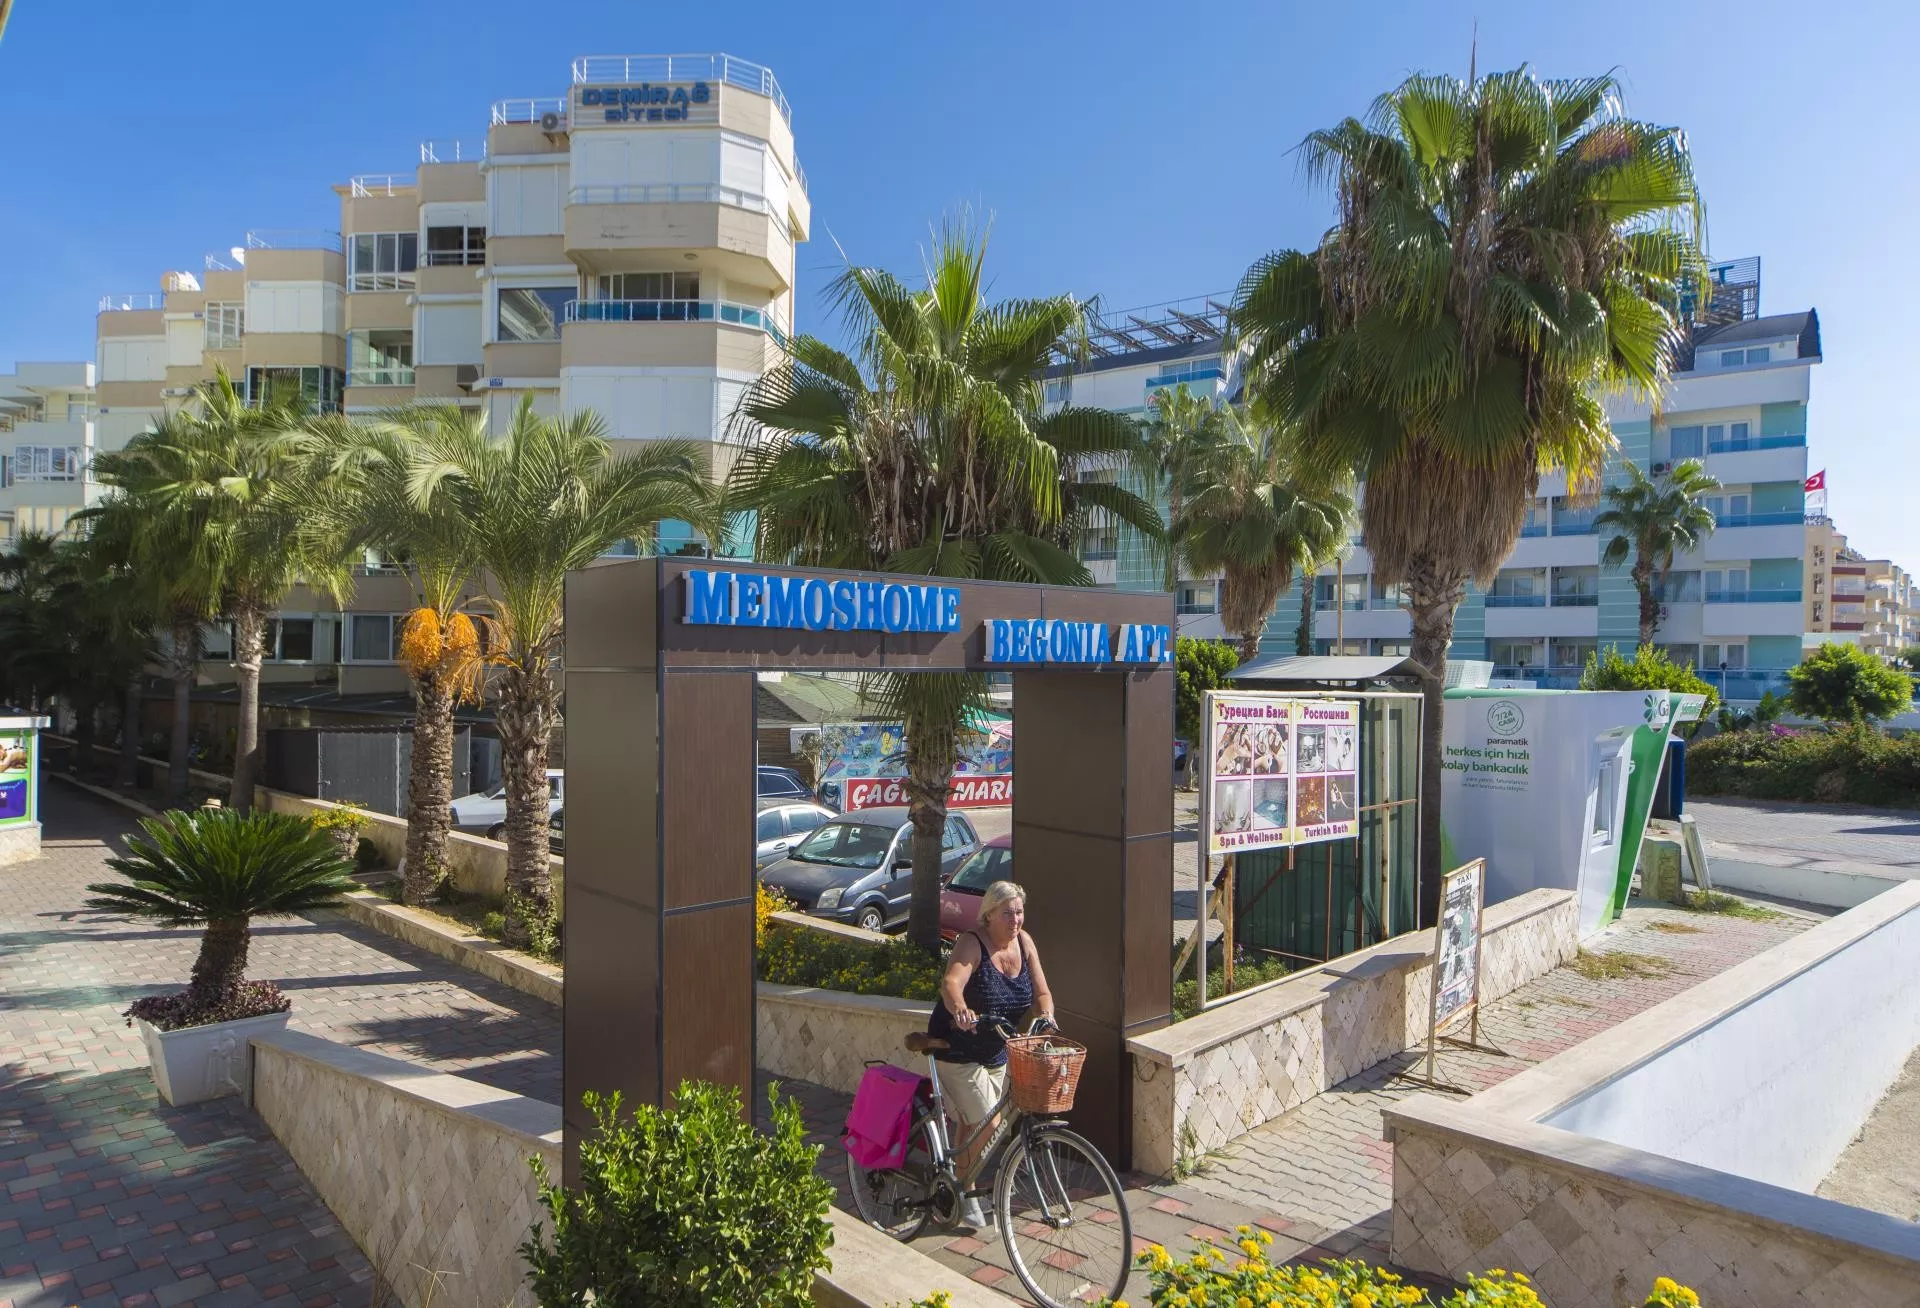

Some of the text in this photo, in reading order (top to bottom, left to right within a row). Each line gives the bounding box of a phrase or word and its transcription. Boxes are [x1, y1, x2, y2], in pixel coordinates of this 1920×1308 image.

[583, 82, 710, 105] DEMİRAĞ
[682, 569, 961, 633] MEMOSHOME
[983, 619, 1174, 663] BEGONIA APT.
[1218, 703, 1289, 719] Турецкая Баня
[1303, 707, 1349, 720] Роскошная
[1487, 738, 1528, 746] paramatik
[1446, 745, 1529, 760] herkes için hızlı
[1441, 760, 1528, 774] kolay bankacılık
[1304, 824, 1348, 837] Turkish Bath
[1219, 832, 1283, 848] Spa & Wellness
